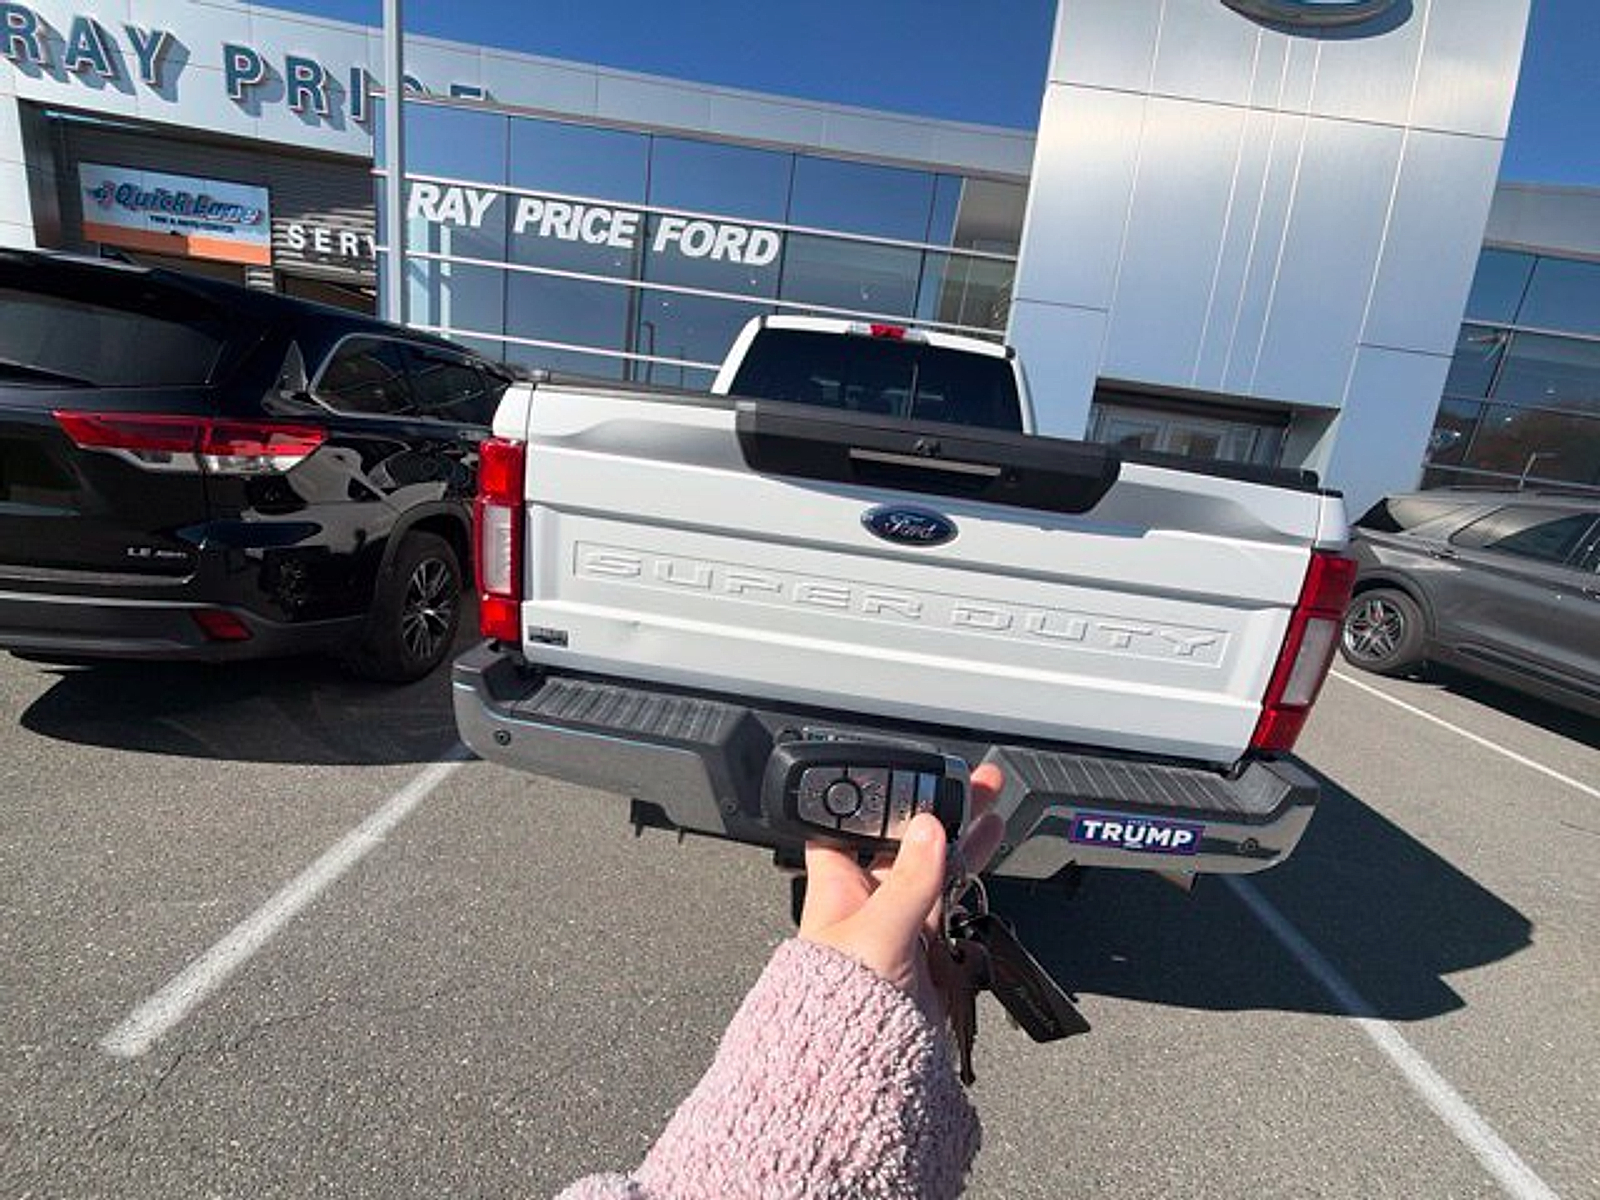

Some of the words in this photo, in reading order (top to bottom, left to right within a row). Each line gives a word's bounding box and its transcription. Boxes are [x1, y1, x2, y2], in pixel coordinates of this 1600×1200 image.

[0, 3, 167, 85] RAY
[222, 42, 483, 121] PRI
[406, 182, 496, 227] RAY
[513, 197, 640, 249] PRICE
[652, 216, 781, 267] FORD
[583, 551, 923, 618] SUPER
[950, 600, 1218, 657] DUTY
[1081, 820, 1194, 847] TRUMP
